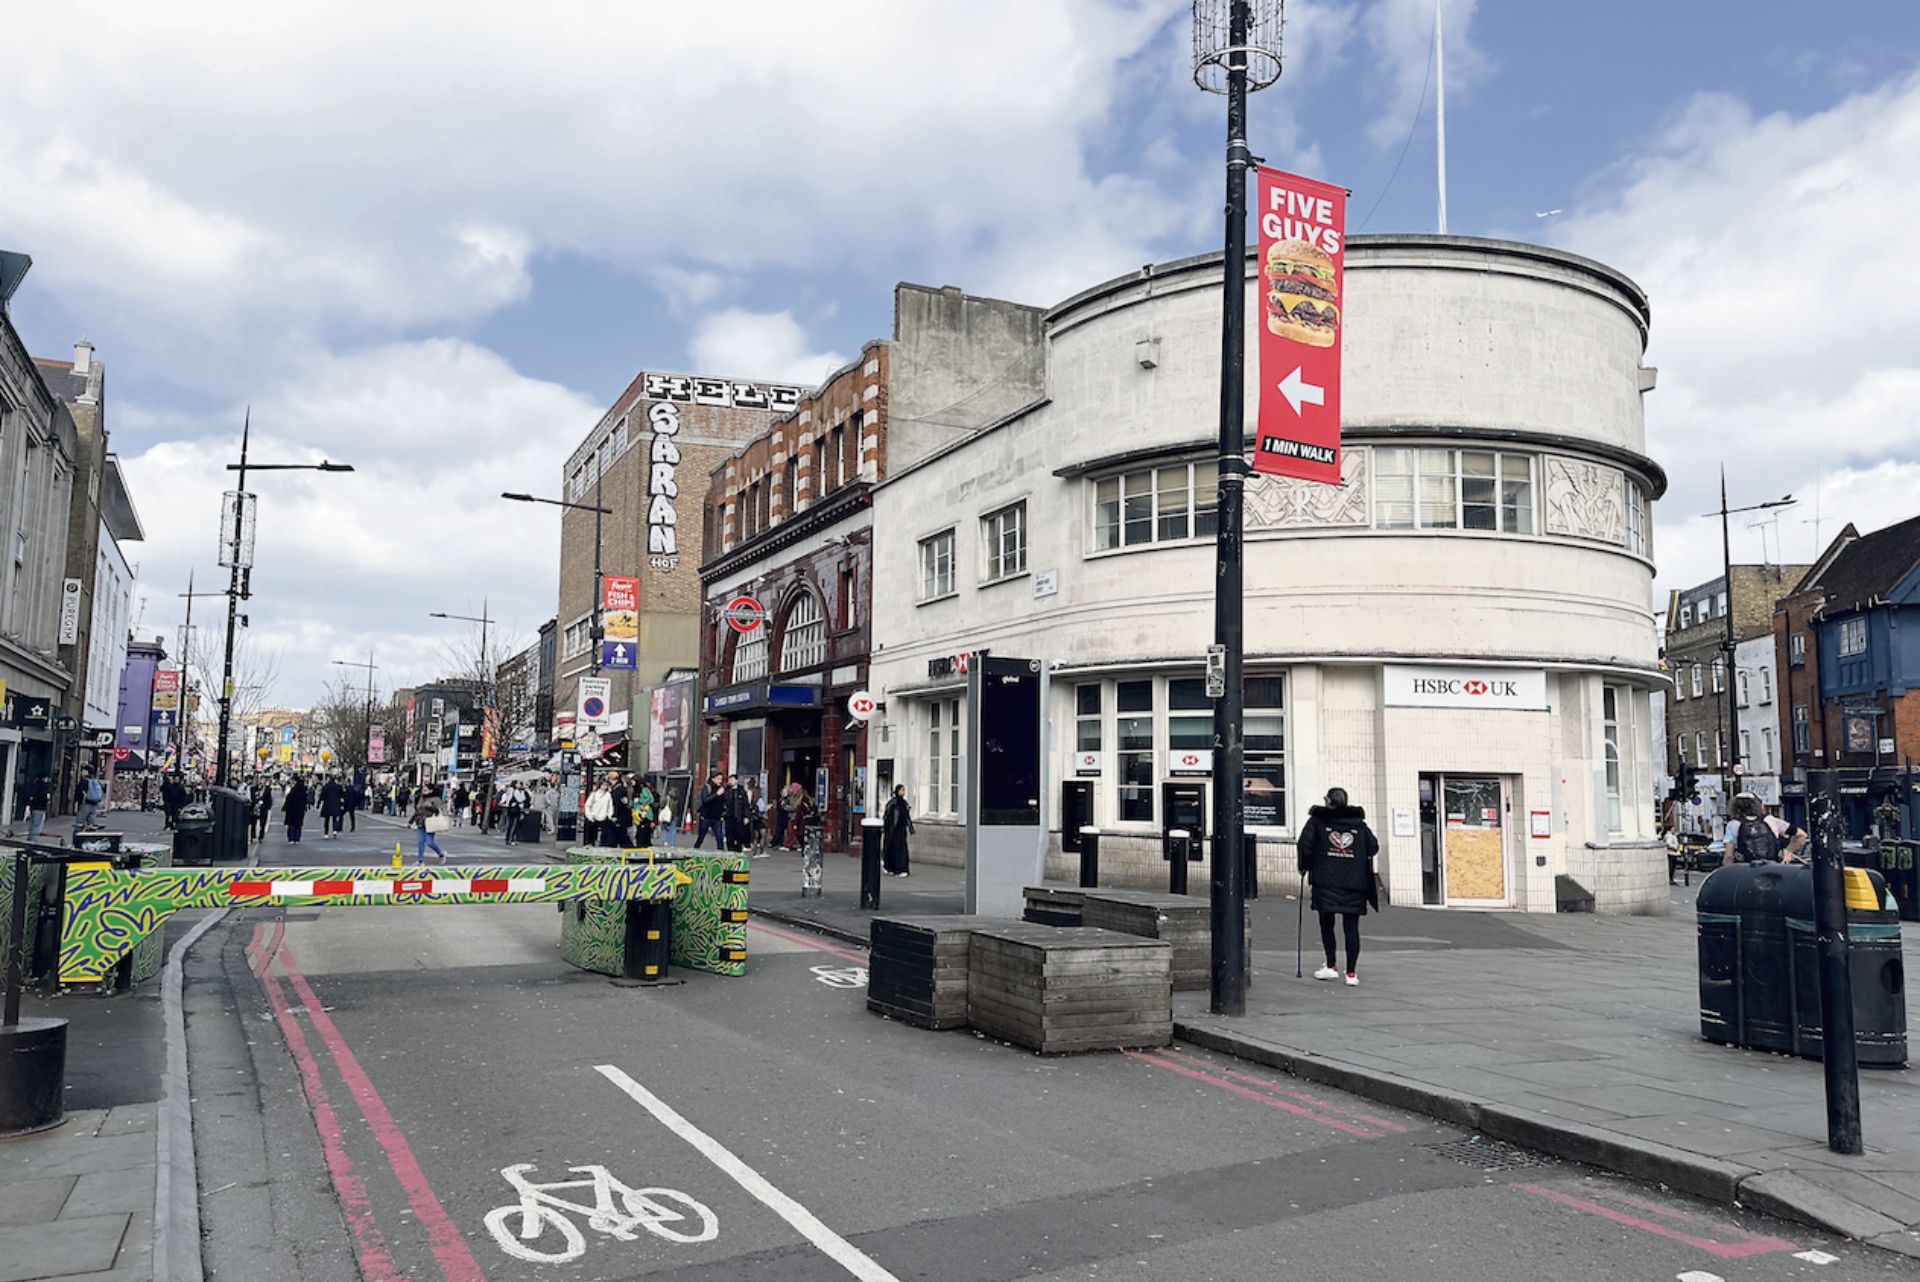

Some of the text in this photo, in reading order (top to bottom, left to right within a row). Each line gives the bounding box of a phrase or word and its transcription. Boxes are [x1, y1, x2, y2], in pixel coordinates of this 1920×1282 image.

[1270, 186, 1333, 226] FIVE
[1262, 212, 1341, 254] GUYS
[1264, 438, 1335, 464] 1 MIN WALK
[1413, 678, 1517, 697] HSBC UK
